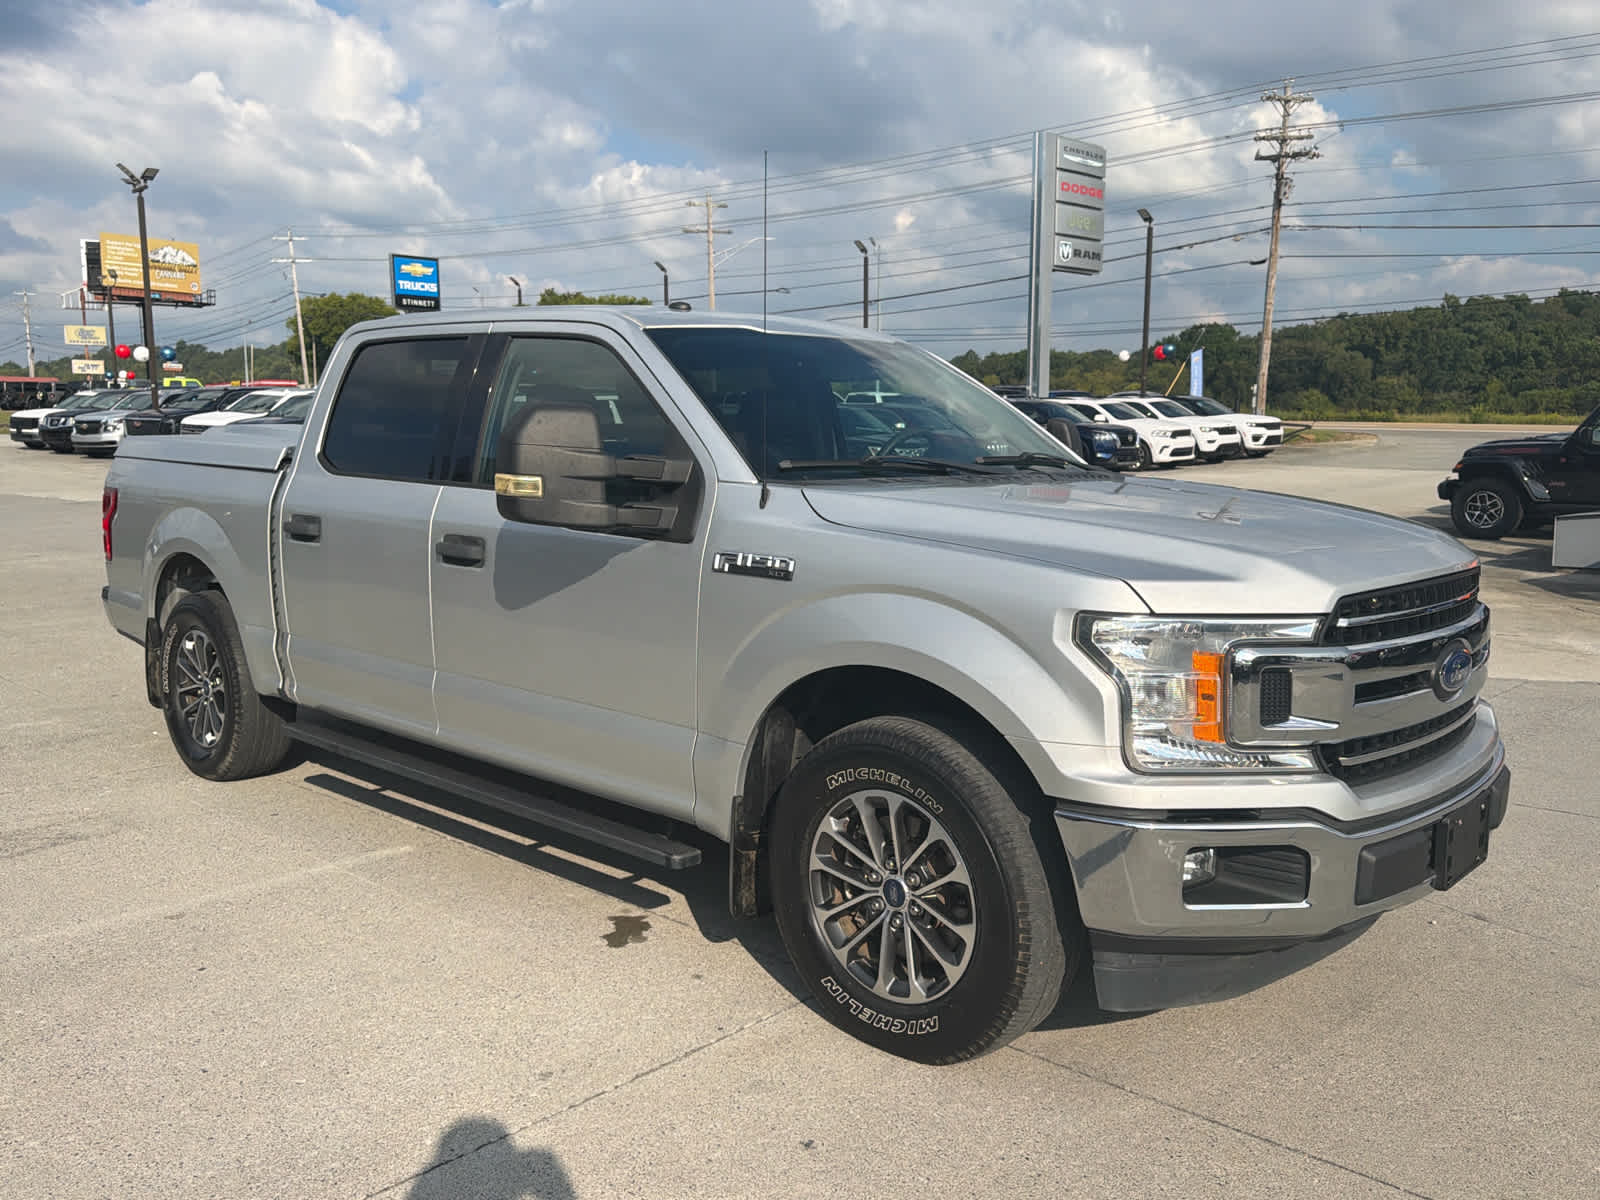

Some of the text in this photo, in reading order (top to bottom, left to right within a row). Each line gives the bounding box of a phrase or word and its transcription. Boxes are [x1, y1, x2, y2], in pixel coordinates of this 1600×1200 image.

[1061, 181, 1104, 200] DODGE
[1073, 248, 1102, 262] RAM
[398, 279, 438, 293] TRUCKS
[402, 298, 435, 308] STINNETT
[826, 767, 944, 815] MICHELIN
[820, 975, 940, 1036] MICHELIN
